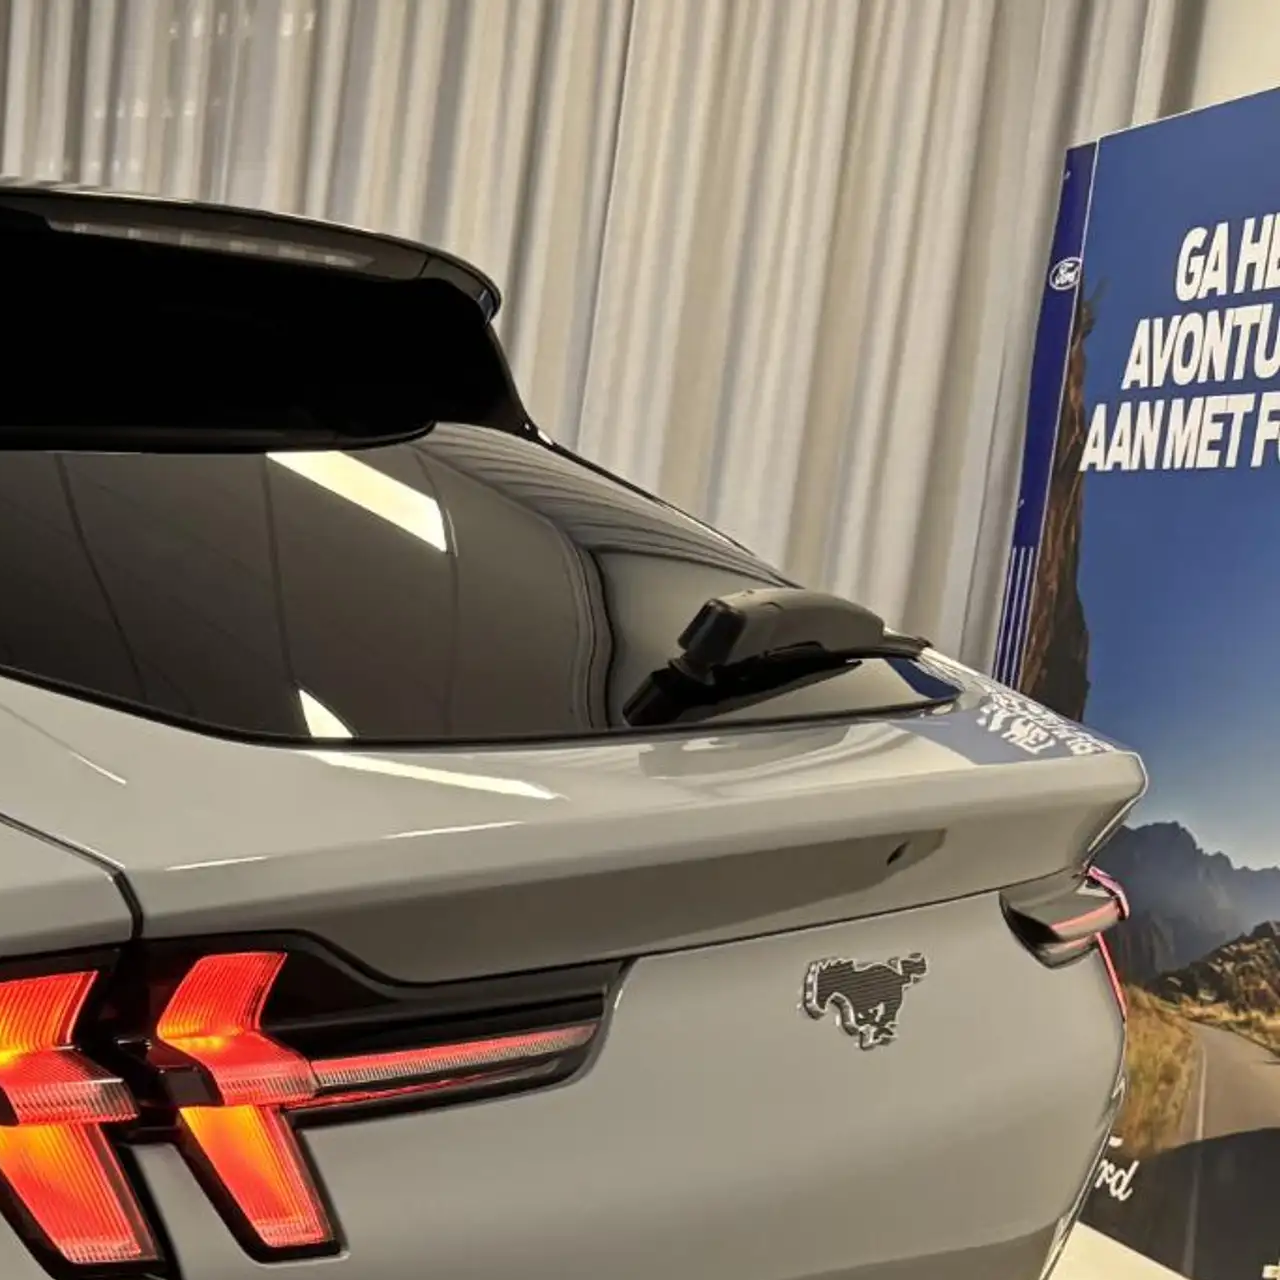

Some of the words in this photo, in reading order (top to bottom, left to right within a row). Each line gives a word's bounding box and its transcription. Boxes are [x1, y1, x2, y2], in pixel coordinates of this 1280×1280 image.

[1176, 223, 1229, 301] GA
[1121, 304, 1280, 389] AVONTU
[1080, 400, 1164, 471] AAN
[1162, 393, 1255, 470] MET
[1250, 392, 1280, 467] F
